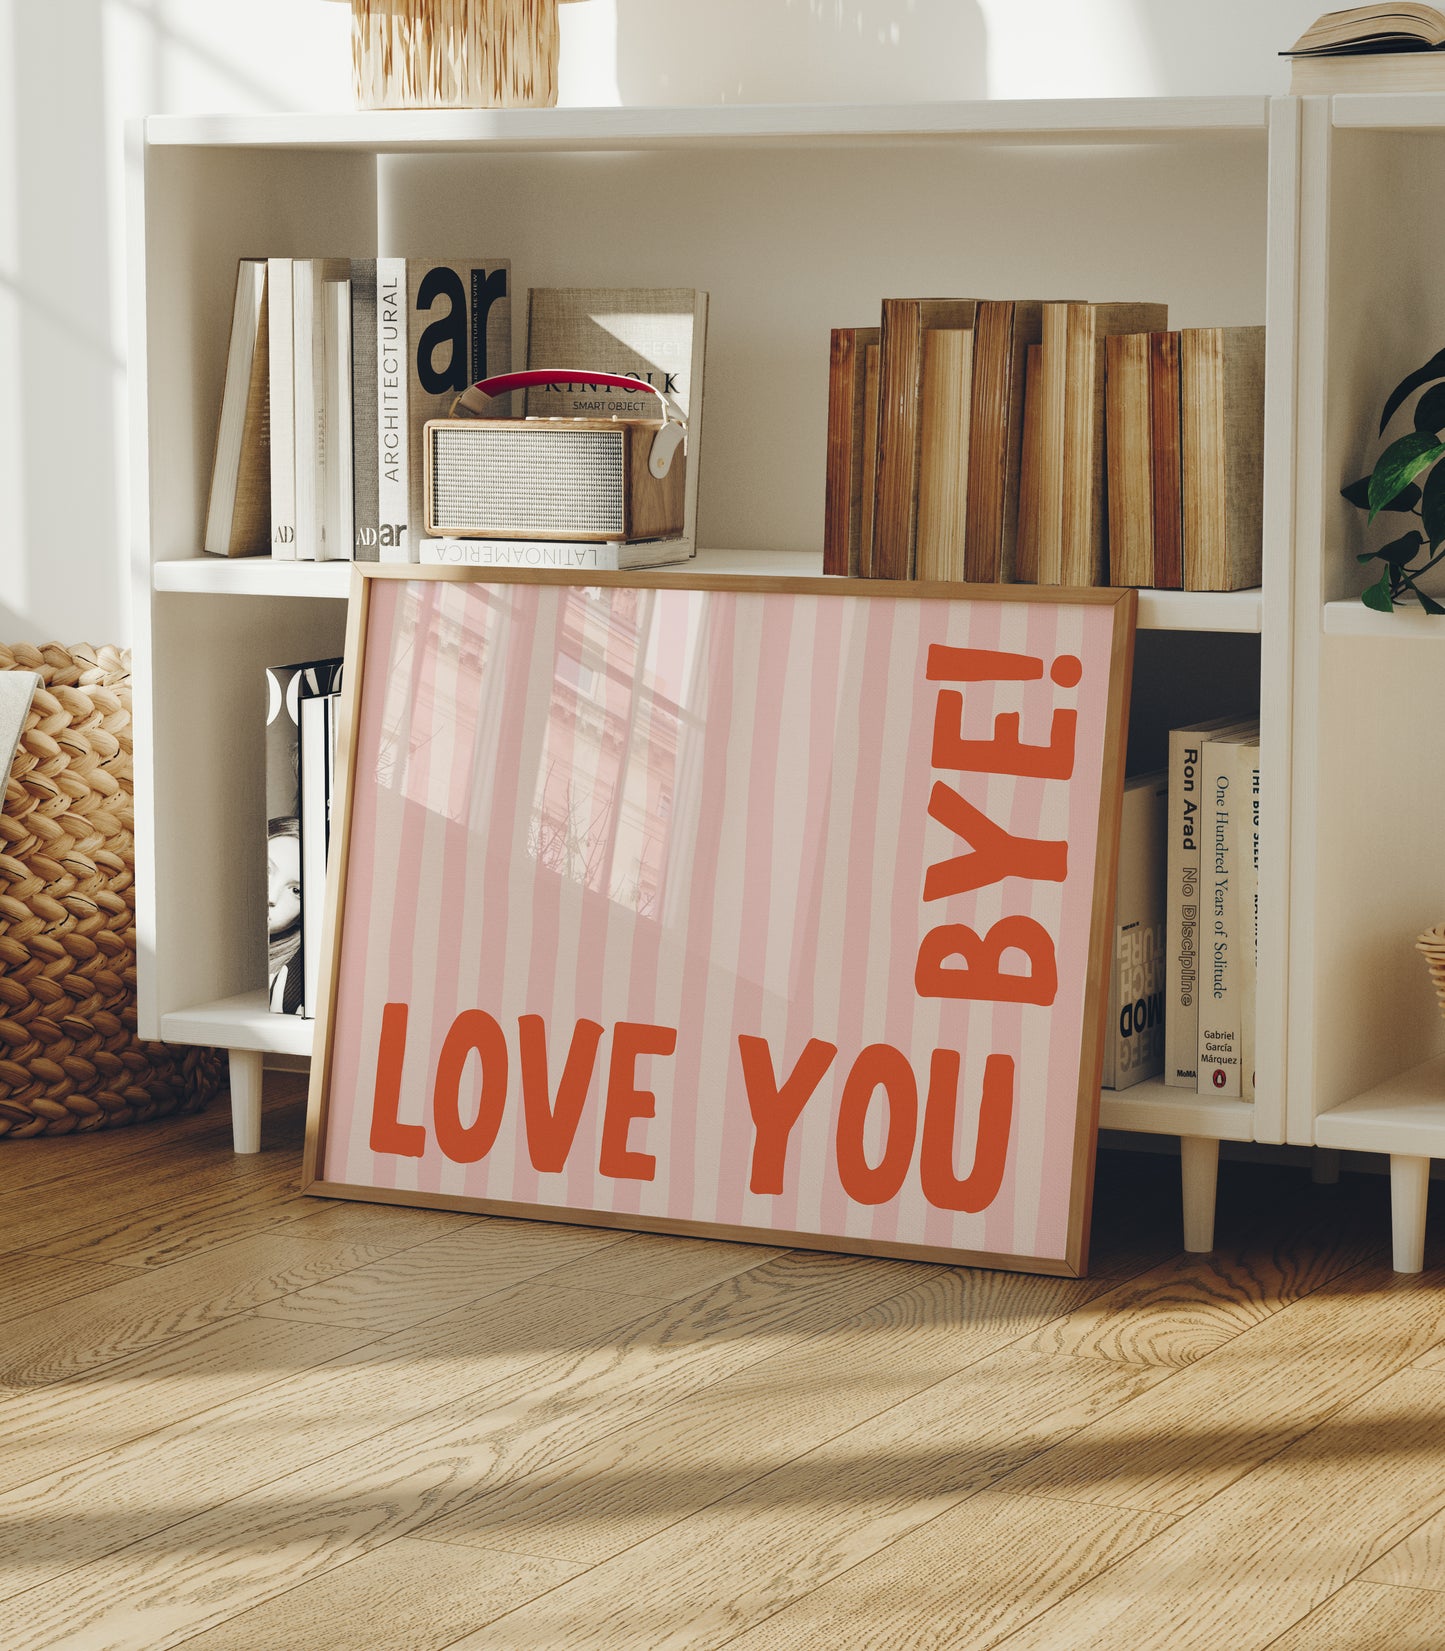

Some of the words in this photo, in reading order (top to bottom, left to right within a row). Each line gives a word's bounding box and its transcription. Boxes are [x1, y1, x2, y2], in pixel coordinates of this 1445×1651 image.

[416, 266, 506, 395] ar
[382, 277, 399, 483] ARCHITECTURAL
[573, 401, 605, 411] SMART
[607, 401, 646, 412] OBJECT
[274, 525, 294, 544] AD
[356, 527, 377, 546] AD
[379, 523, 408, 548] ar
[435, 543, 598, 567] LATINOAMERICA
[1184, 749, 1198, 792] Ron
[1216, 775, 1230, 807] One
[915, 644, 1082, 1006] BYE!
[1183, 799, 1198, 850] Arad
[1215, 811, 1229, 874] Hundred
[1182, 867, 1197, 897] No
[1214, 879, 1229, 917] Years
[1214, 920, 1228, 938] of
[1178, 905, 1197, 1007] Discipline
[1213, 942, 1228, 1000] Solitude
[1120, 993, 1163, 1039] MOD
[1204, 1030, 1235, 1041] Gabriel
[1205, 1042, 1232, 1052] García
[1177, 1069, 1197, 1079] MoMA
[1201, 1054, 1237, 1065] Márquez
[370, 1003, 676, 1180] LOVE
[738, 1035, 1014, 1213] YOU
